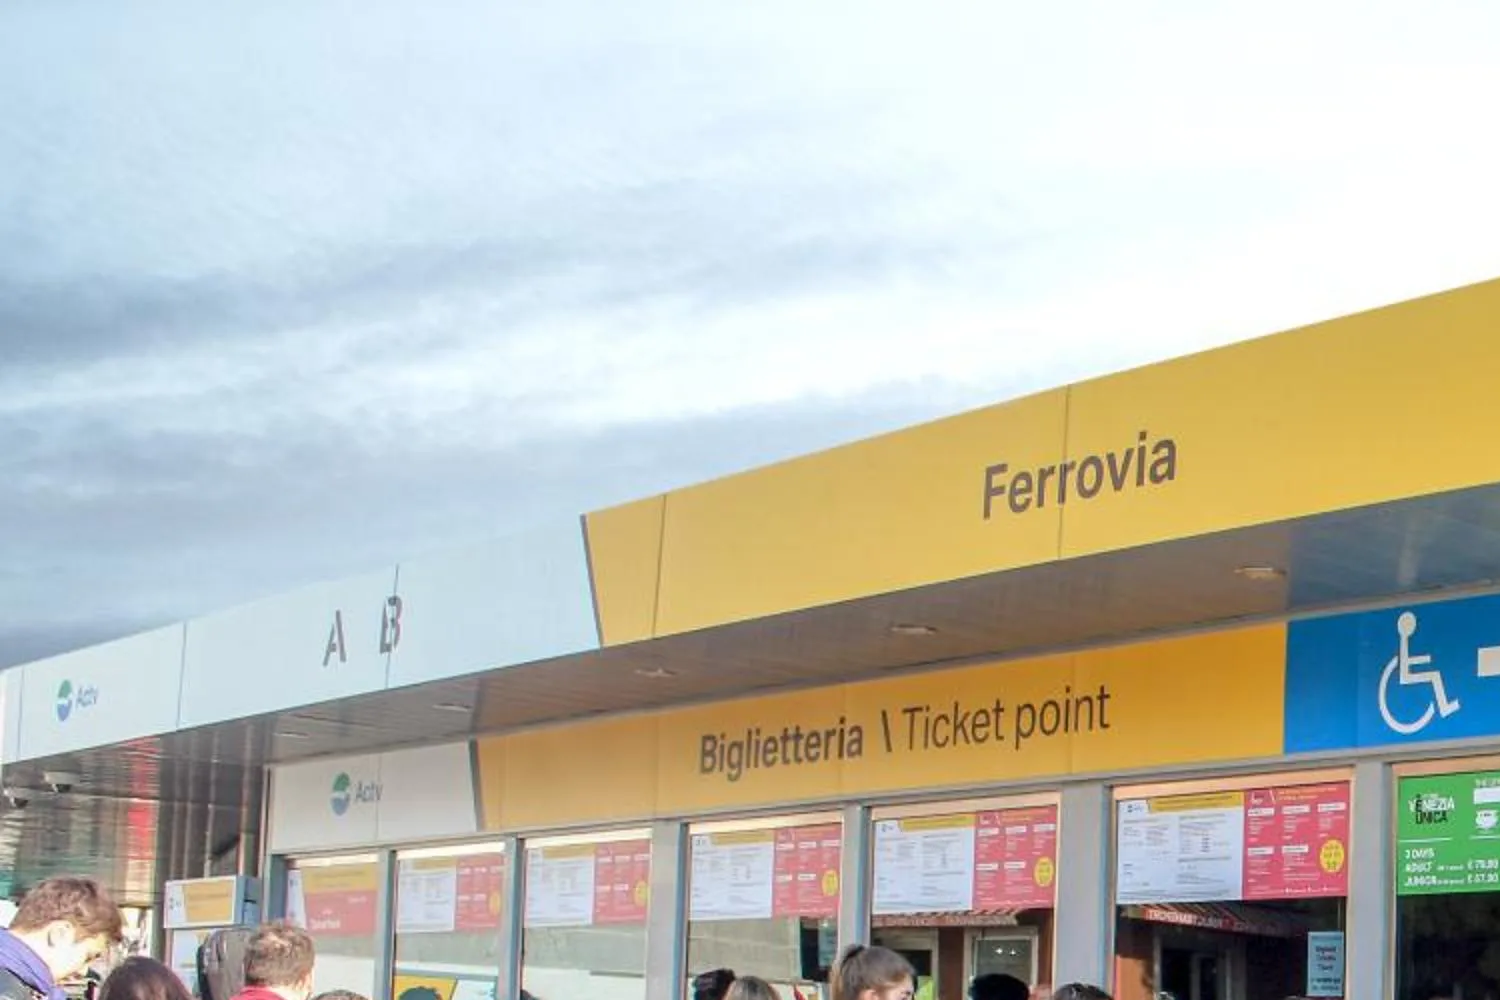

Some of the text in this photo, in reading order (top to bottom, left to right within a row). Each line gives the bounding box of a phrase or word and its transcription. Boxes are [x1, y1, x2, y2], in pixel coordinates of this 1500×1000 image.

[983, 430, 1178, 520] Ferrovia
[322, 595, 402, 667] A B
[700, 715, 864, 782] Biglietteria
[902, 698, 1005, 753] Ticket
[1014, 684, 1111, 751] point
[1416, 810, 1449, 824] UNICA
